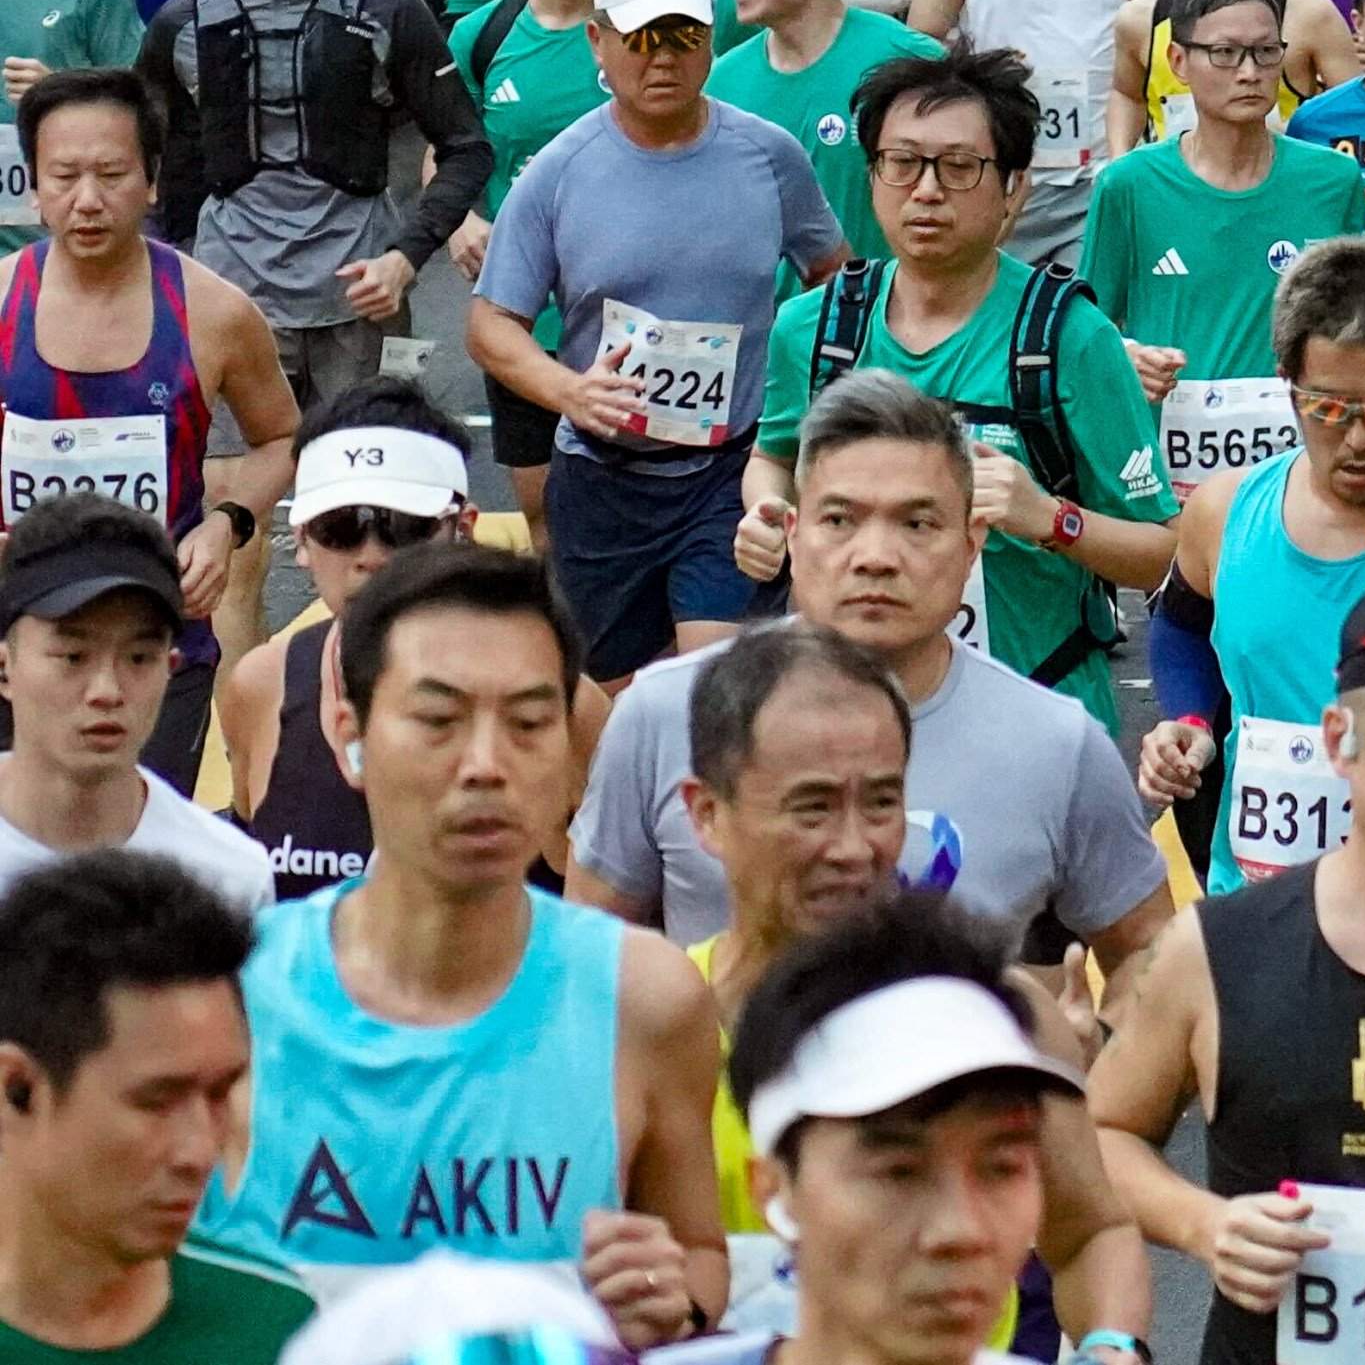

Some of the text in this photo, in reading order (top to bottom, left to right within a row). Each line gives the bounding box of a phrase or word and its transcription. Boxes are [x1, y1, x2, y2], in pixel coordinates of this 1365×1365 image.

[1034, 107, 1079, 139] 31
[343, 447, 385, 469] Y-3
[1166, 425, 1297, 469] B5653
[402, 1155, 571, 1239] AKIV
